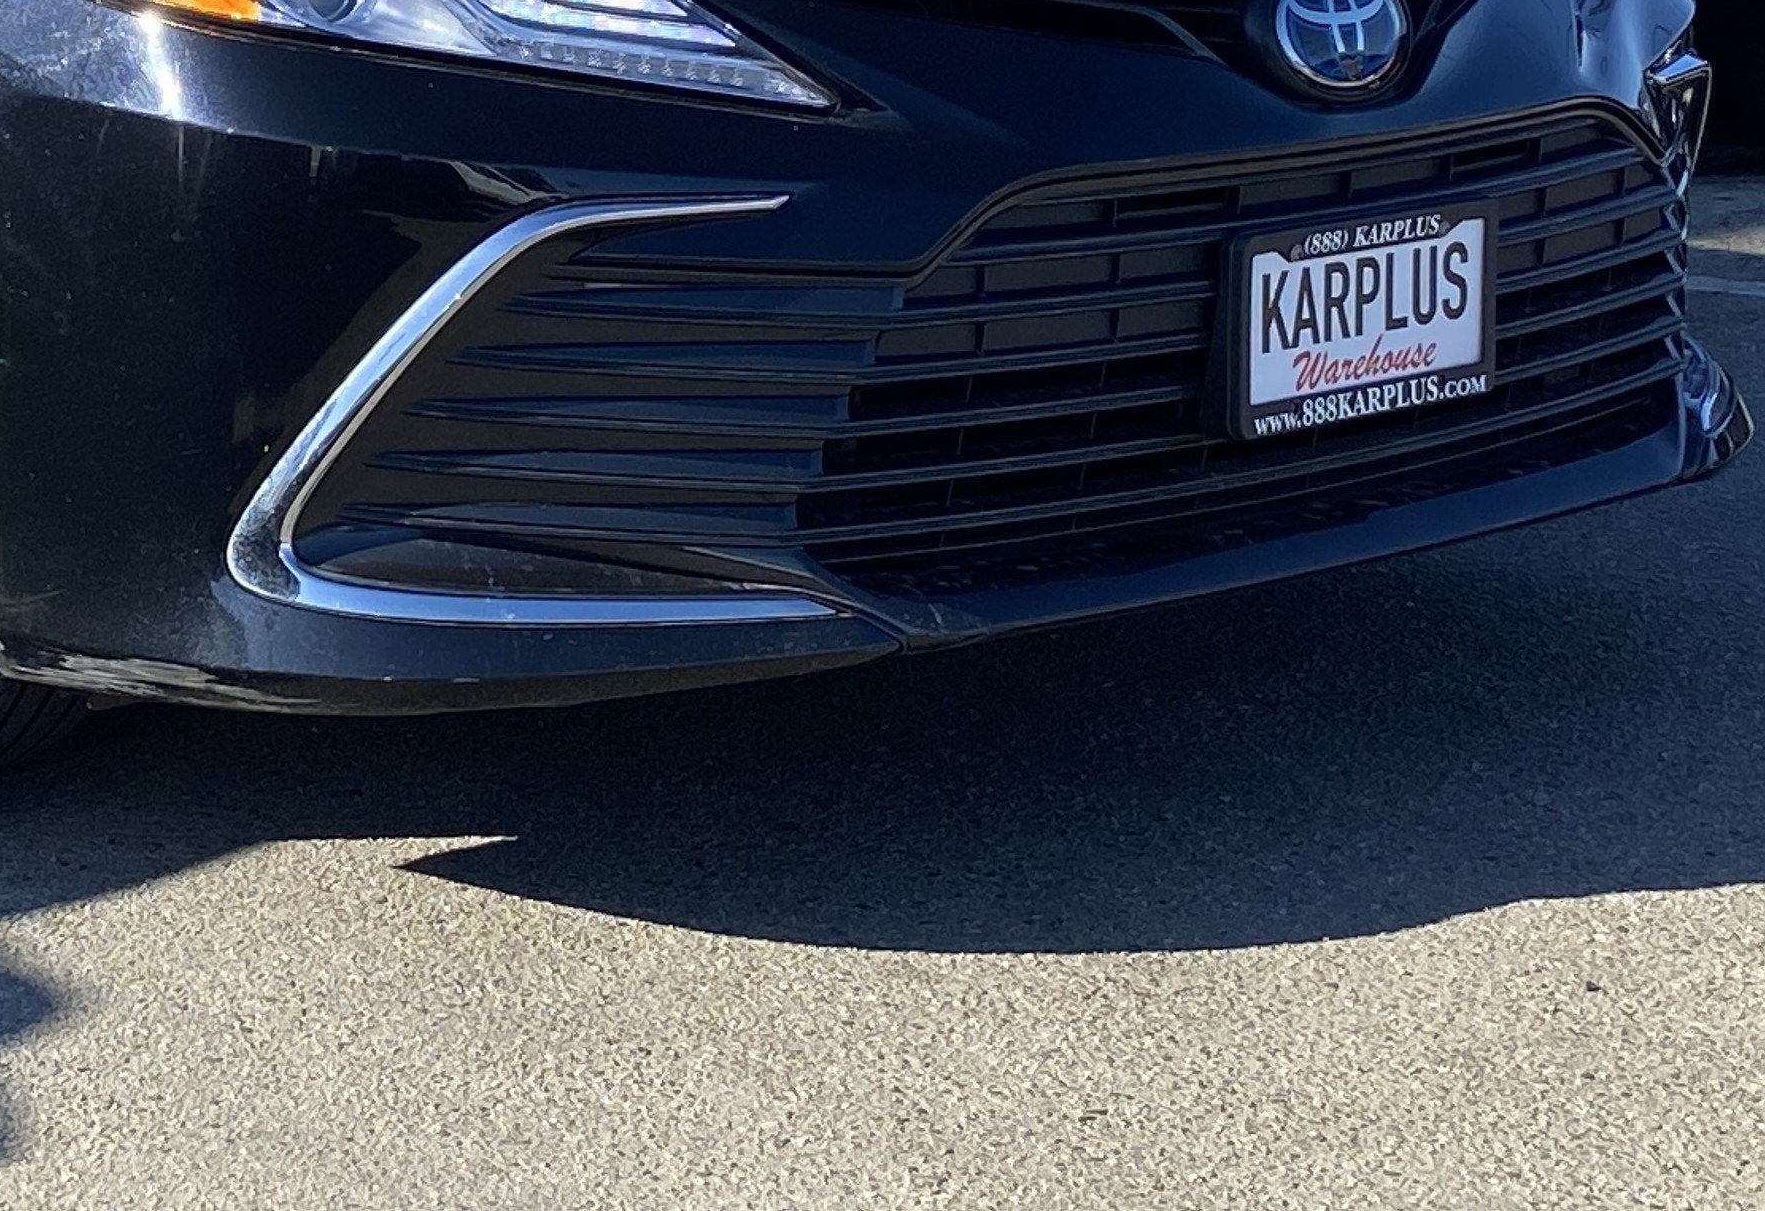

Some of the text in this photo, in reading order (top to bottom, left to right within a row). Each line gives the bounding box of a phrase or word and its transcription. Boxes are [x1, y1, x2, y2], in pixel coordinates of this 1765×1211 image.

[1303, 213, 1442, 254] (888) KARPLUS
[1261, 240, 1469, 354] KARPLUS
[1292, 333, 1437, 392] Warehouse
